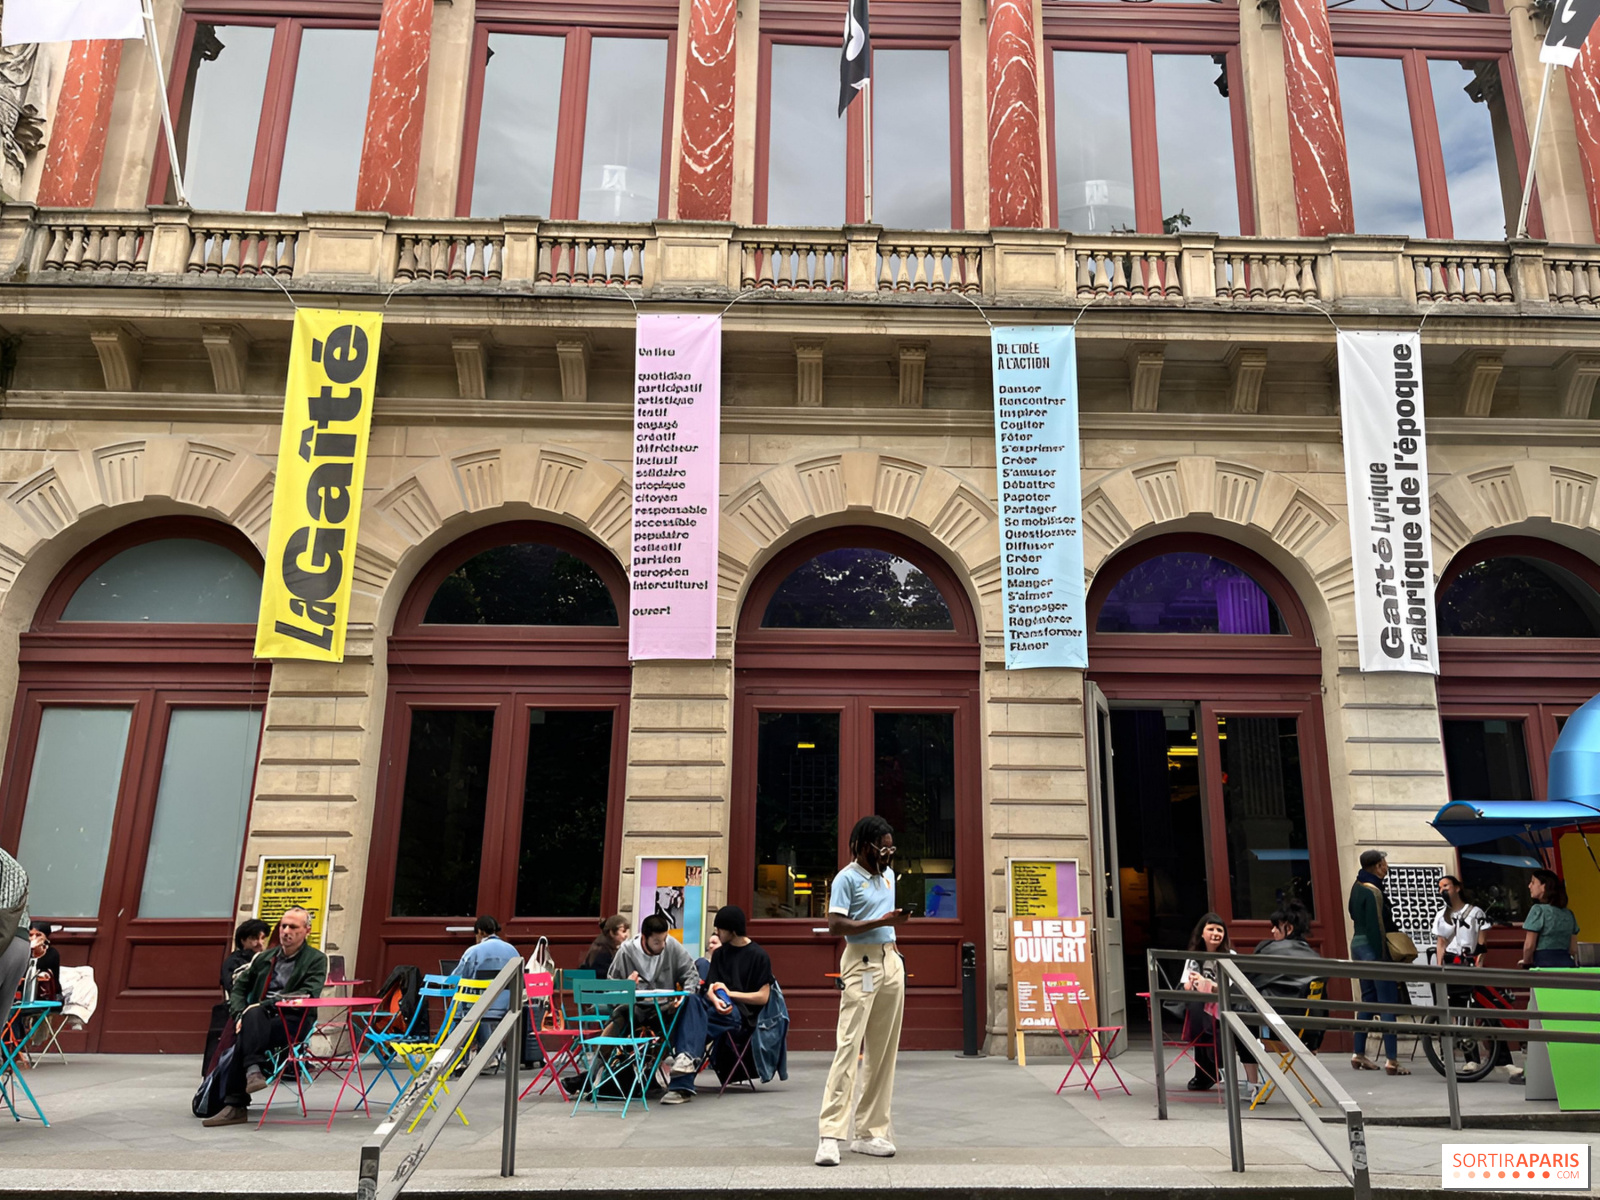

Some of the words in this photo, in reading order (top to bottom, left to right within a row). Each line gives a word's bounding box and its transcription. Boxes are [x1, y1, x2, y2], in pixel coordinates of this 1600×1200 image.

[638, 347, 652, 357] Un
[654, 347, 675, 357] lieu
[997, 343, 1009, 355] DE
[1006, 356, 1050, 369] L'ACTION
[638, 371, 692, 382] quotidien
[638, 383, 702, 394] participatif
[999, 385, 1042, 394] Danser
[637, 396, 694, 406] artistique
[999, 396, 1066, 406] Rencontrer
[637, 407, 668, 417] festif
[1392, 343, 1421, 471] l'époque
[1000, 408, 1048, 418] Inspirer
[637, 420, 679, 430] engagé
[636, 432, 676, 442] créatif
[1001, 433, 1033, 442] Fêter
[636, 444, 699, 454] défricheur
[1002, 444, 1065, 453] S'exprimer
[282, 324, 369, 601] Gaîté
[636, 456, 678, 466] inclusif
[636, 468, 686, 478] solidaire
[1003, 468, 1056, 478] S'amuser
[635, 480, 686, 491] utopique
[1003, 480, 1055, 490] Débattre
[635, 493, 678, 504] citoyen
[1003, 493, 1051, 502] Papoter
[1367, 461, 1395, 534] Lyrique
[1396, 476, 1421, 516] de
[635, 505, 708, 516] responsable
[1004, 505, 1057, 514] Partager
[634, 518, 697, 528] accessible
[1004, 517, 1019, 527] Se
[1022, 516, 1076, 526] mobiliser
[634, 530, 689, 542] populaire
[1005, 529, 1077, 540] Questionner
[634, 542, 682, 552] collectif
[1006, 541, 1054, 551] Diffuser
[634, 555, 681, 566] parisien
[633, 568, 689, 579] européen
[1007, 566, 1039, 576] Boire
[633, 580, 708, 590] interculturel
[1007, 579, 1053, 589] Manger
[1008, 591, 1053, 601] S'aimer
[1400, 521, 1430, 662] Fabrique
[1372, 537, 1405, 659] Gaîté
[632, 606, 671, 616] ouvert
[1008, 603, 1068, 614] S'engager
[1009, 615, 1072, 627] Régénérer
[1009, 627, 1082, 640] Transformer
[1013, 920, 1085, 938] LIEU
[1014, 937, 1086, 963] OUVERT
